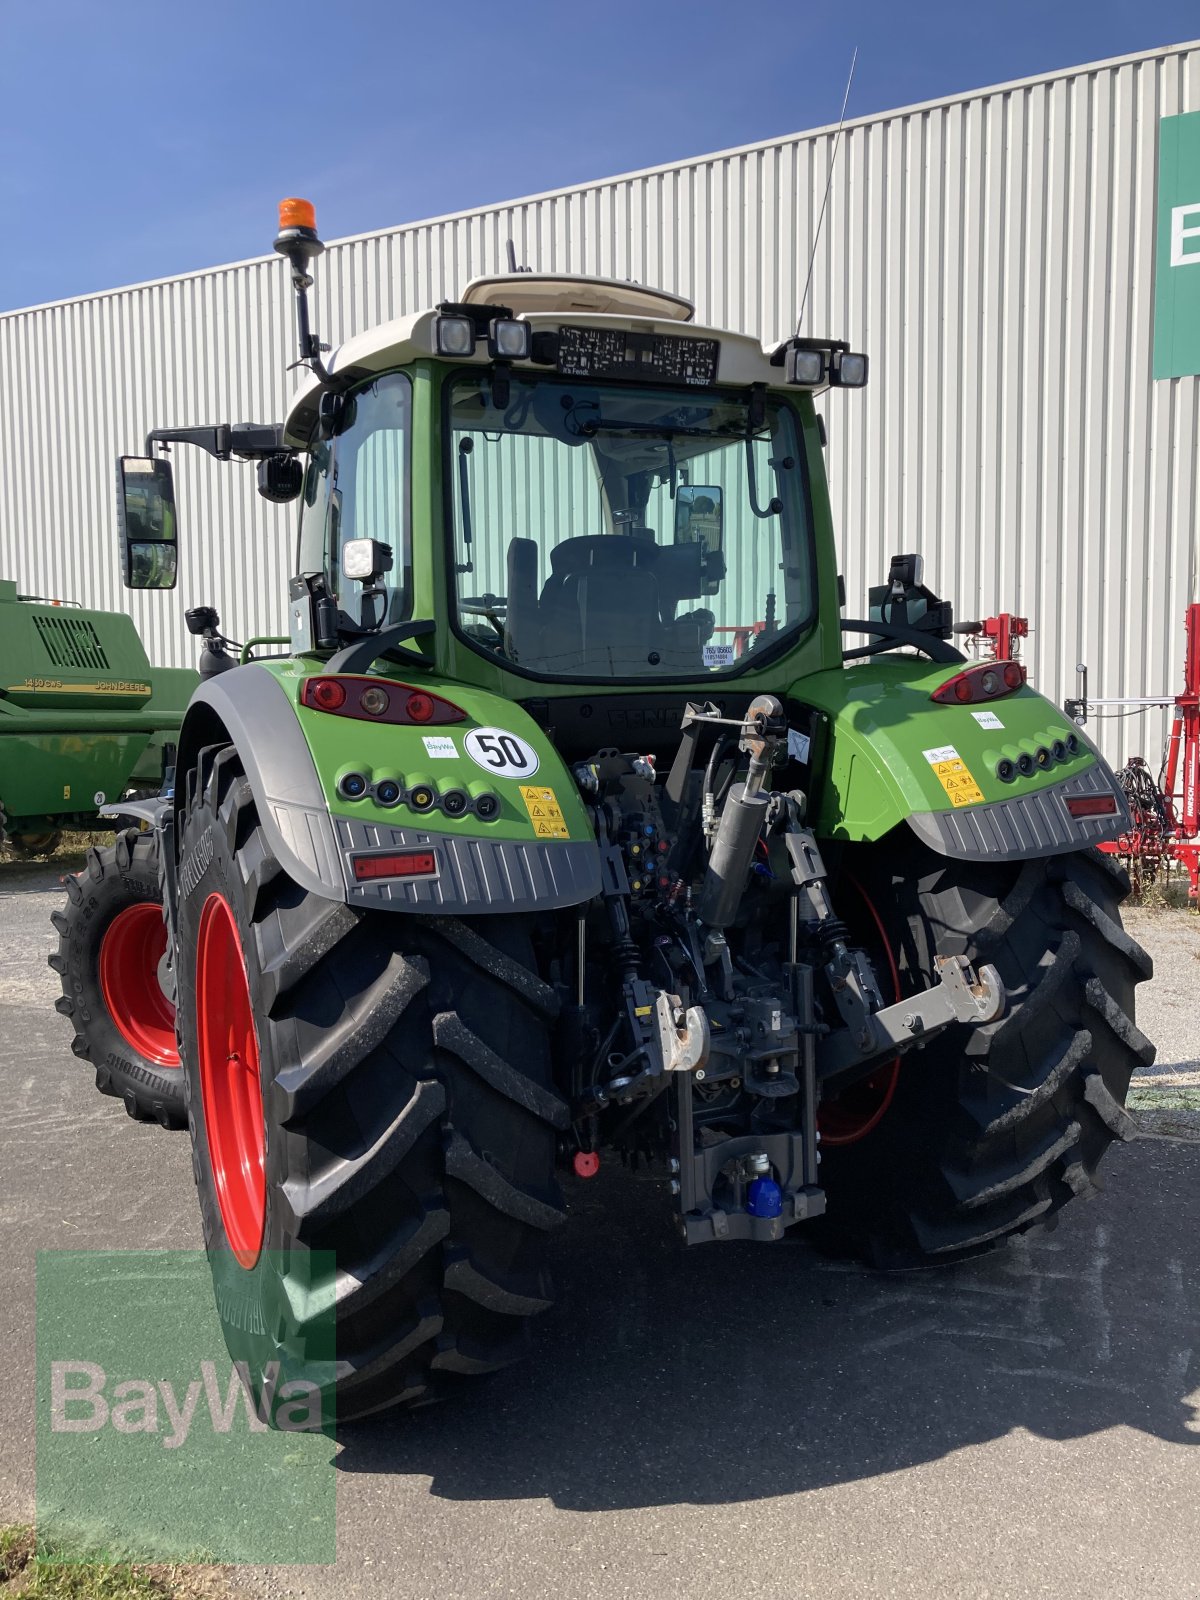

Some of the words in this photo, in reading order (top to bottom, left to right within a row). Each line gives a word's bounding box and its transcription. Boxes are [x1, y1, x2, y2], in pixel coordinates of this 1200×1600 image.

[686, 377, 710, 386] FENDT
[95, 680, 118, 691] JOHN
[117, 681, 146, 692] DEERE
[427, 743, 454, 751] BayWa
[475, 734, 528, 769] 50
